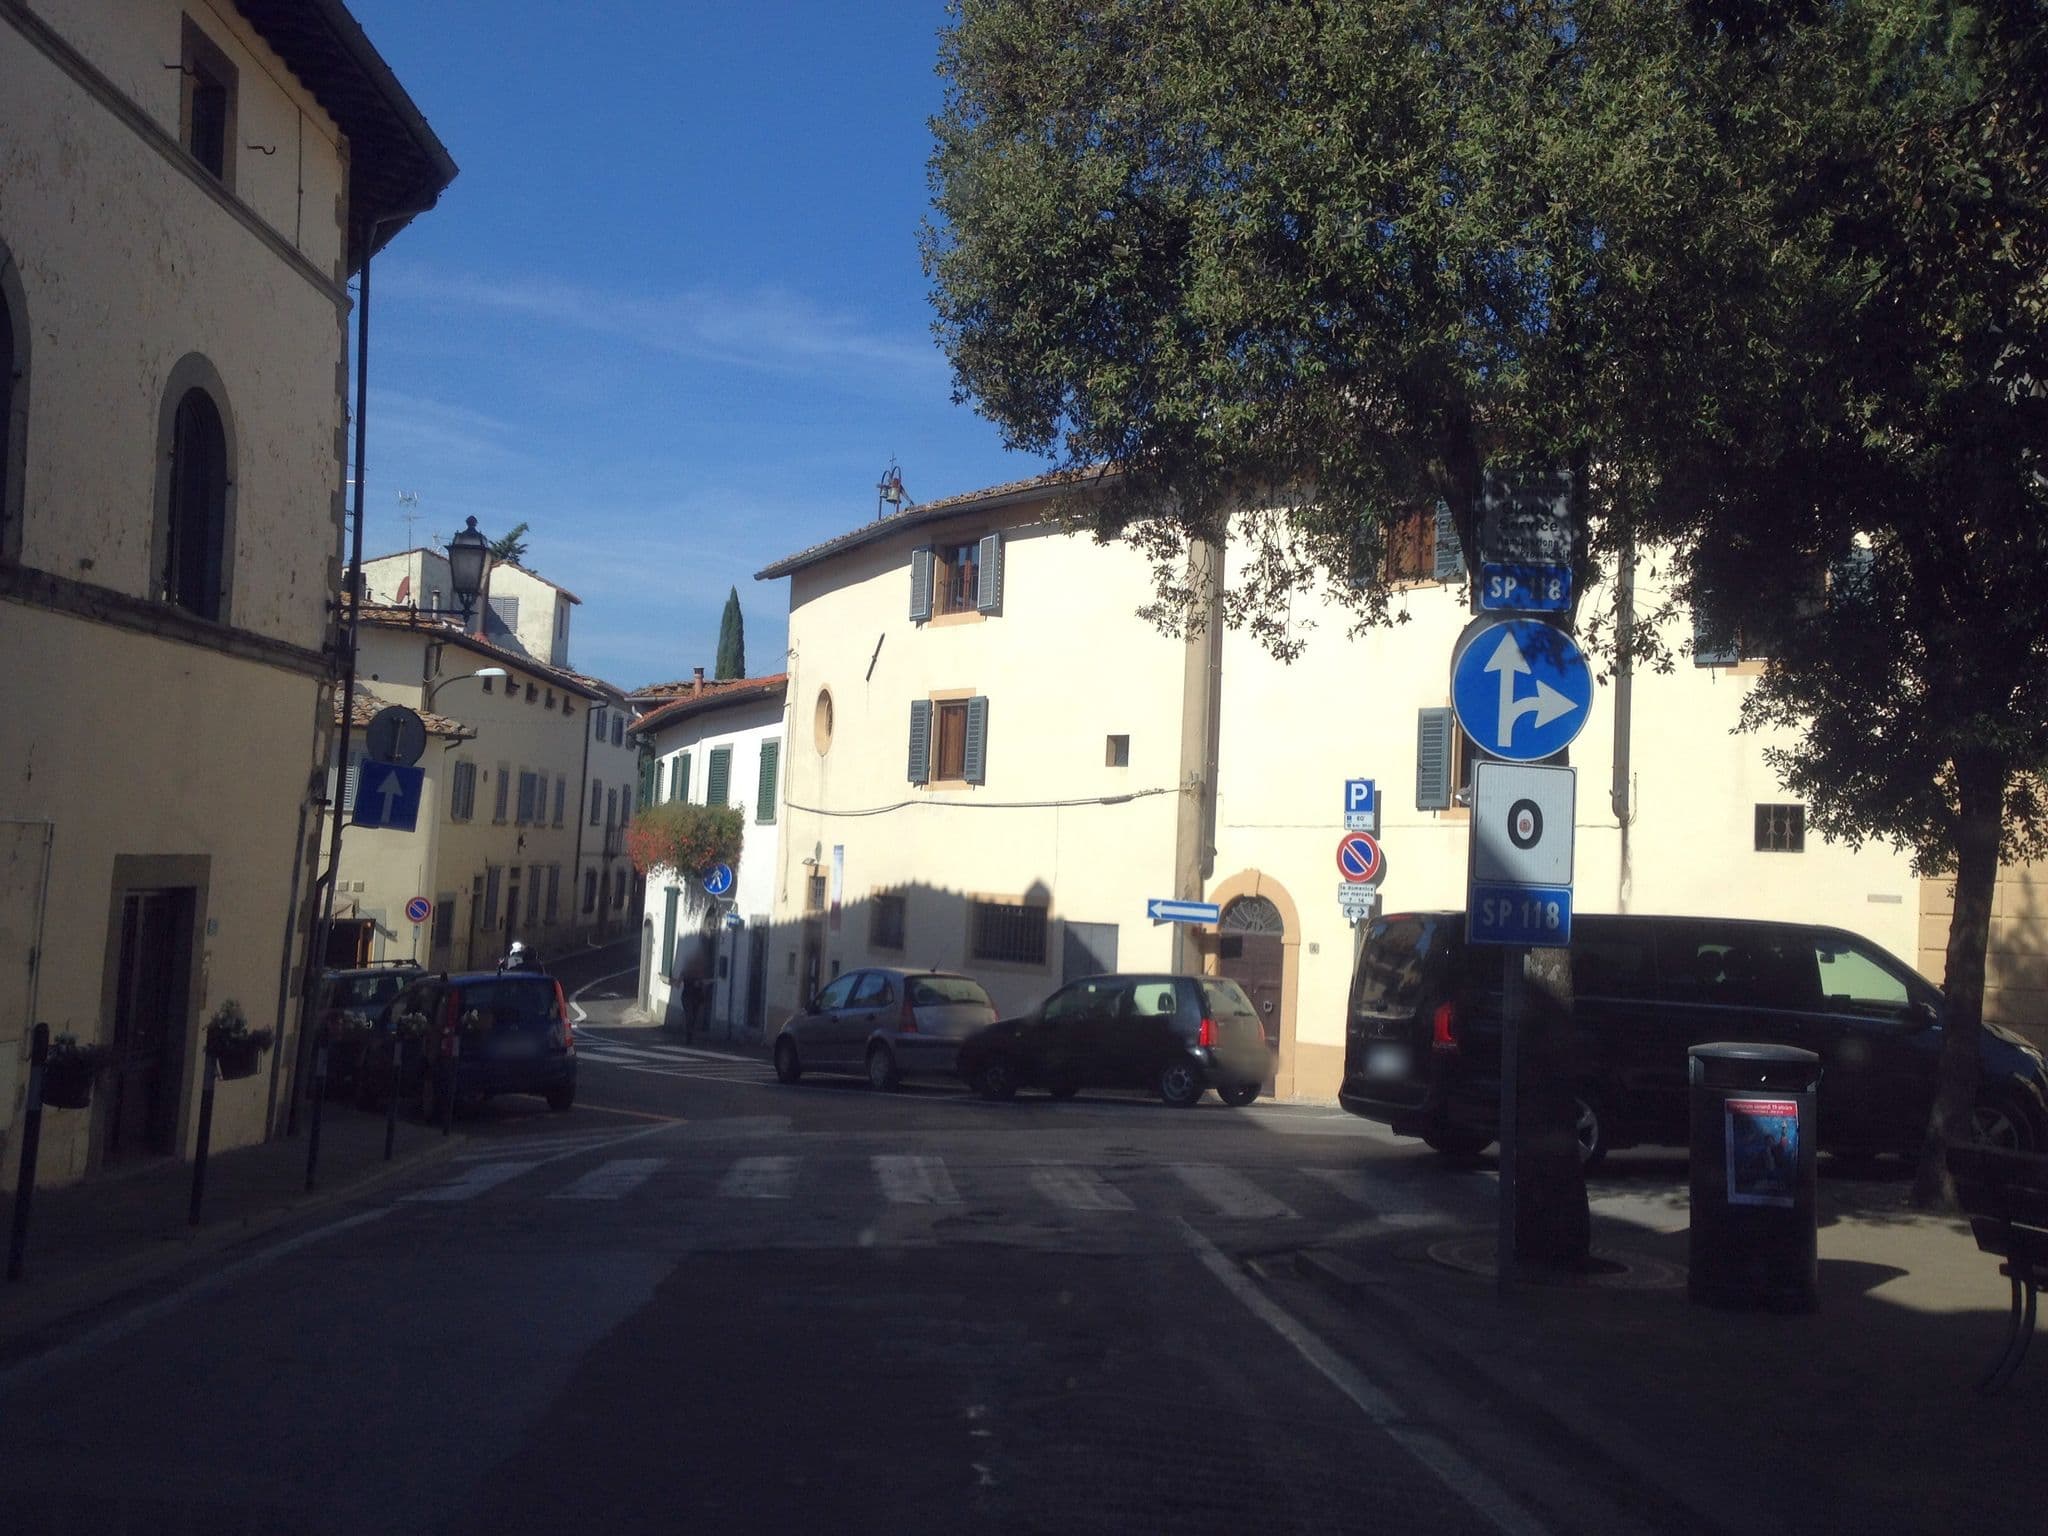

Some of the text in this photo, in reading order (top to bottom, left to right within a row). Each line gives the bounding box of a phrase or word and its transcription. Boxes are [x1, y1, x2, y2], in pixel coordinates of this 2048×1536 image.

[1499, 519, 1558, 533] Service
[1490, 576, 1517, 599] SP
[1351, 783, 1368, 810] P
[1507, 798, 1544, 850] 0
[1483, 898, 1560, 929] SP 118
